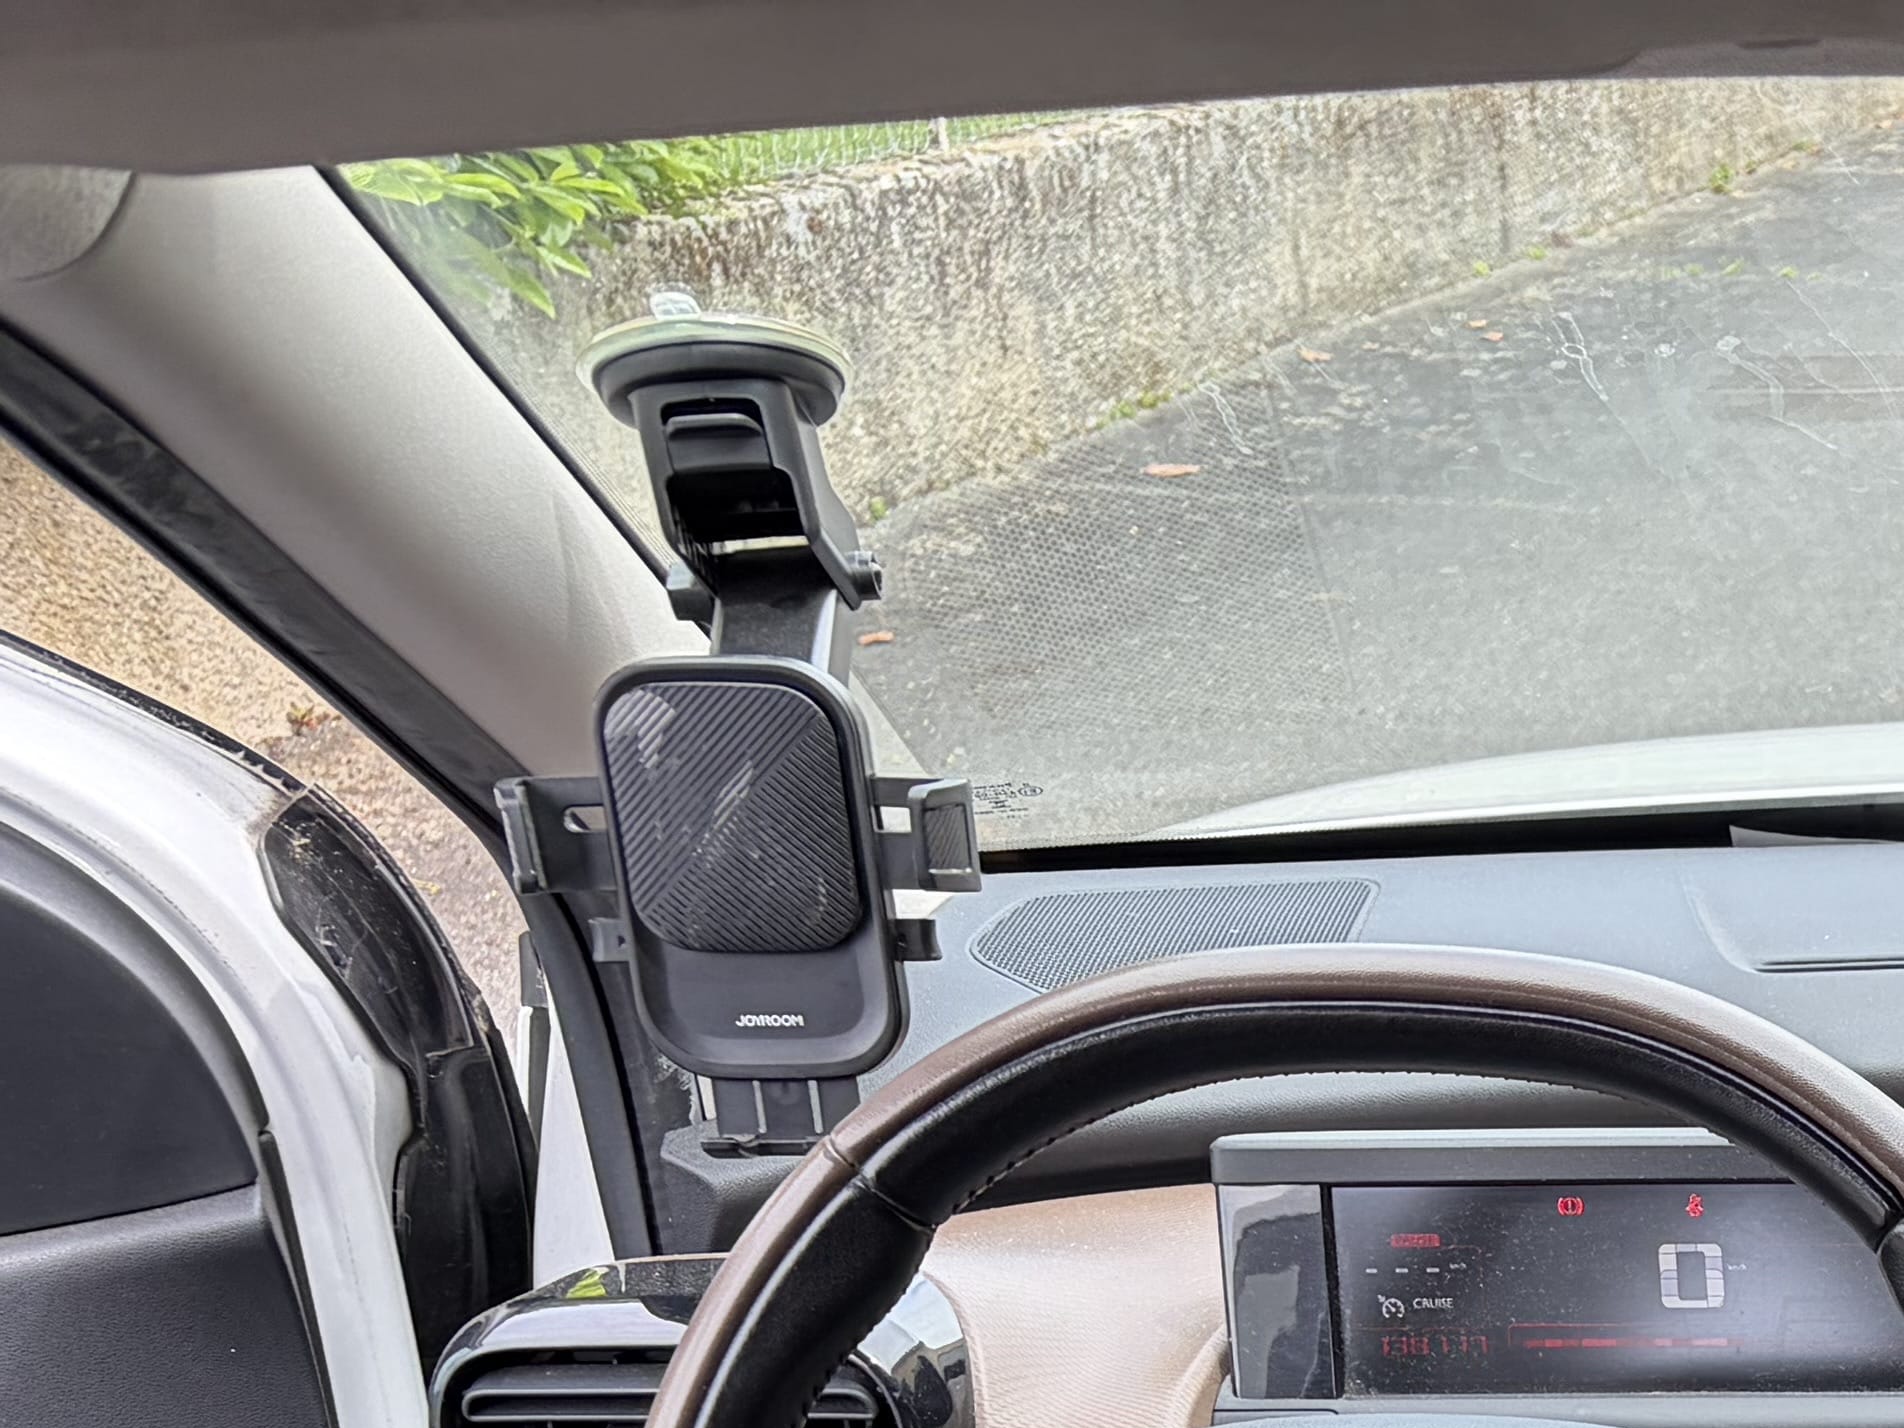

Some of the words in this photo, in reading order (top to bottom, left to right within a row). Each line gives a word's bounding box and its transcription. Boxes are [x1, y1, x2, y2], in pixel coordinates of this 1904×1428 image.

[735, 1013, 805, 1028] JOYROOM
[1657, 1243, 1726, 1309] 0
[1411, 1297, 1455, 1309] CRUISE
